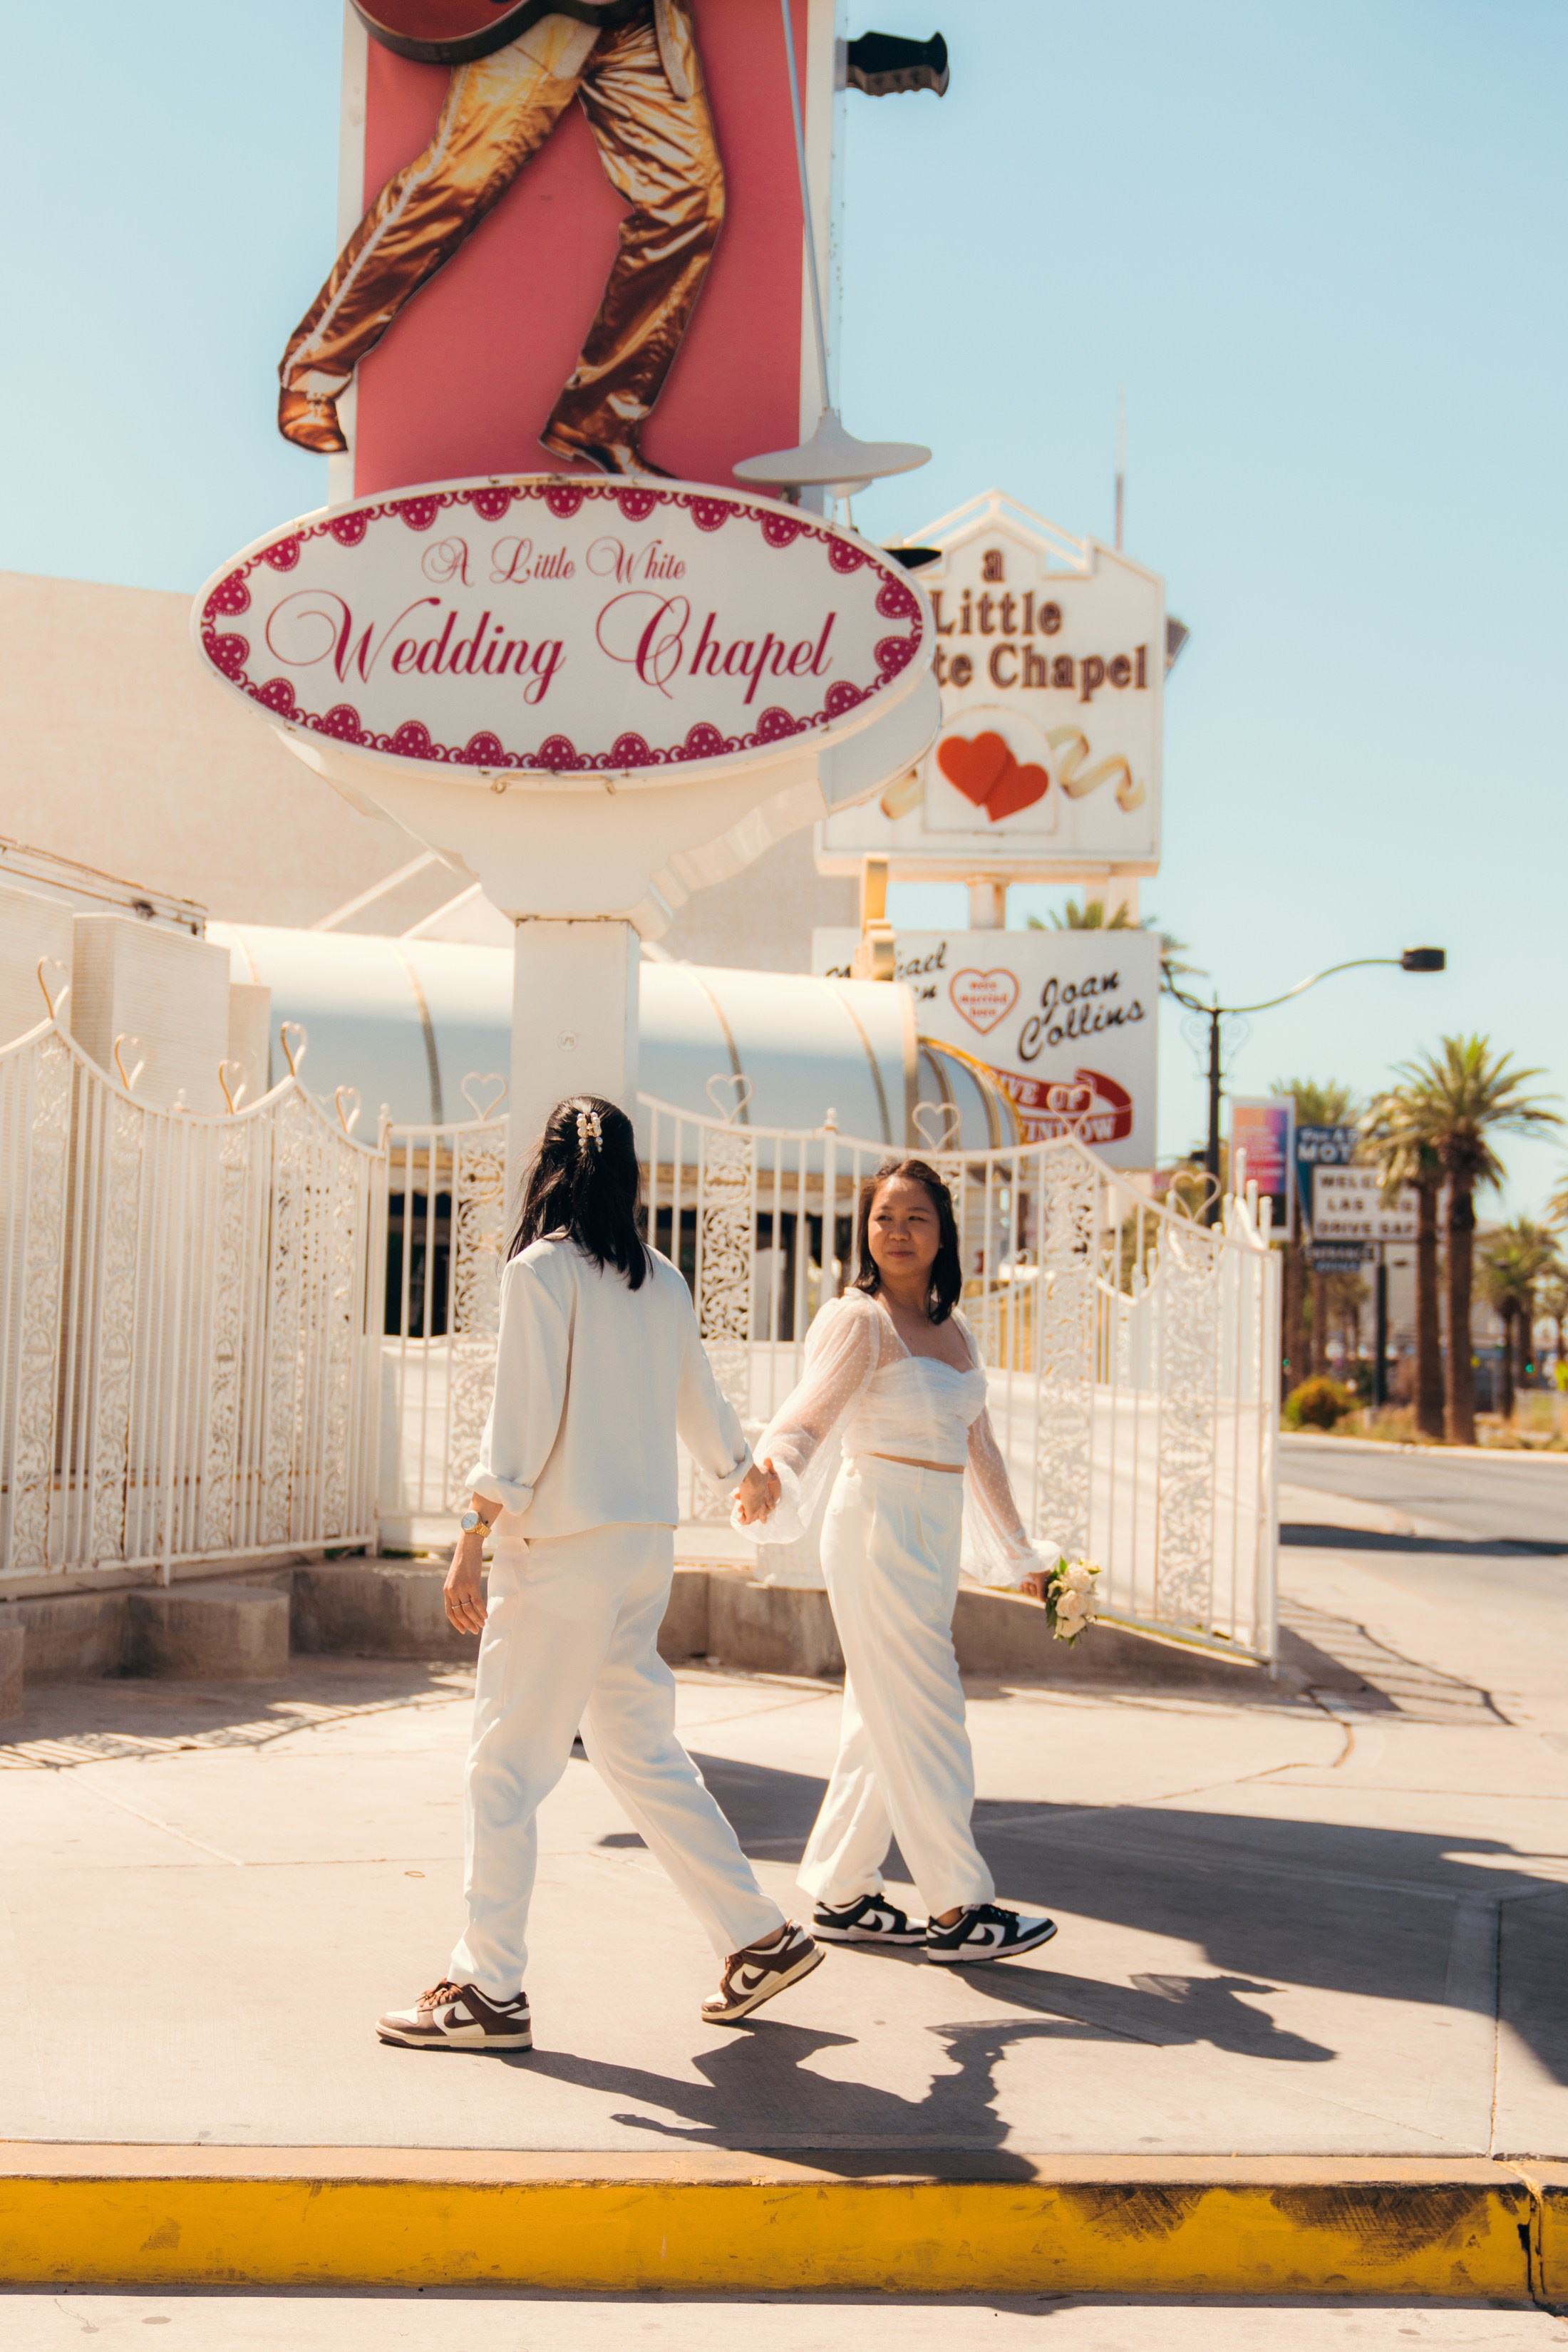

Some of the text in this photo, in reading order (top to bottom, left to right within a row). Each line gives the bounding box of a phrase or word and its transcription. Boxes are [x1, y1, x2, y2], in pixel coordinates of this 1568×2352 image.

[421, 536, 686, 587] A Little White
[981, 549, 1005, 584] a
[929, 588, 1061, 636] Little
[266, 589, 837, 705] Wedding Chapel
[988, 642, 1147, 703] Chapel
[960, 993, 1007, 1004] married
[969, 981, 997, 991] were
[1041, 971, 1119, 1026] Joan
[1018, 999, 1145, 1063] Collins
